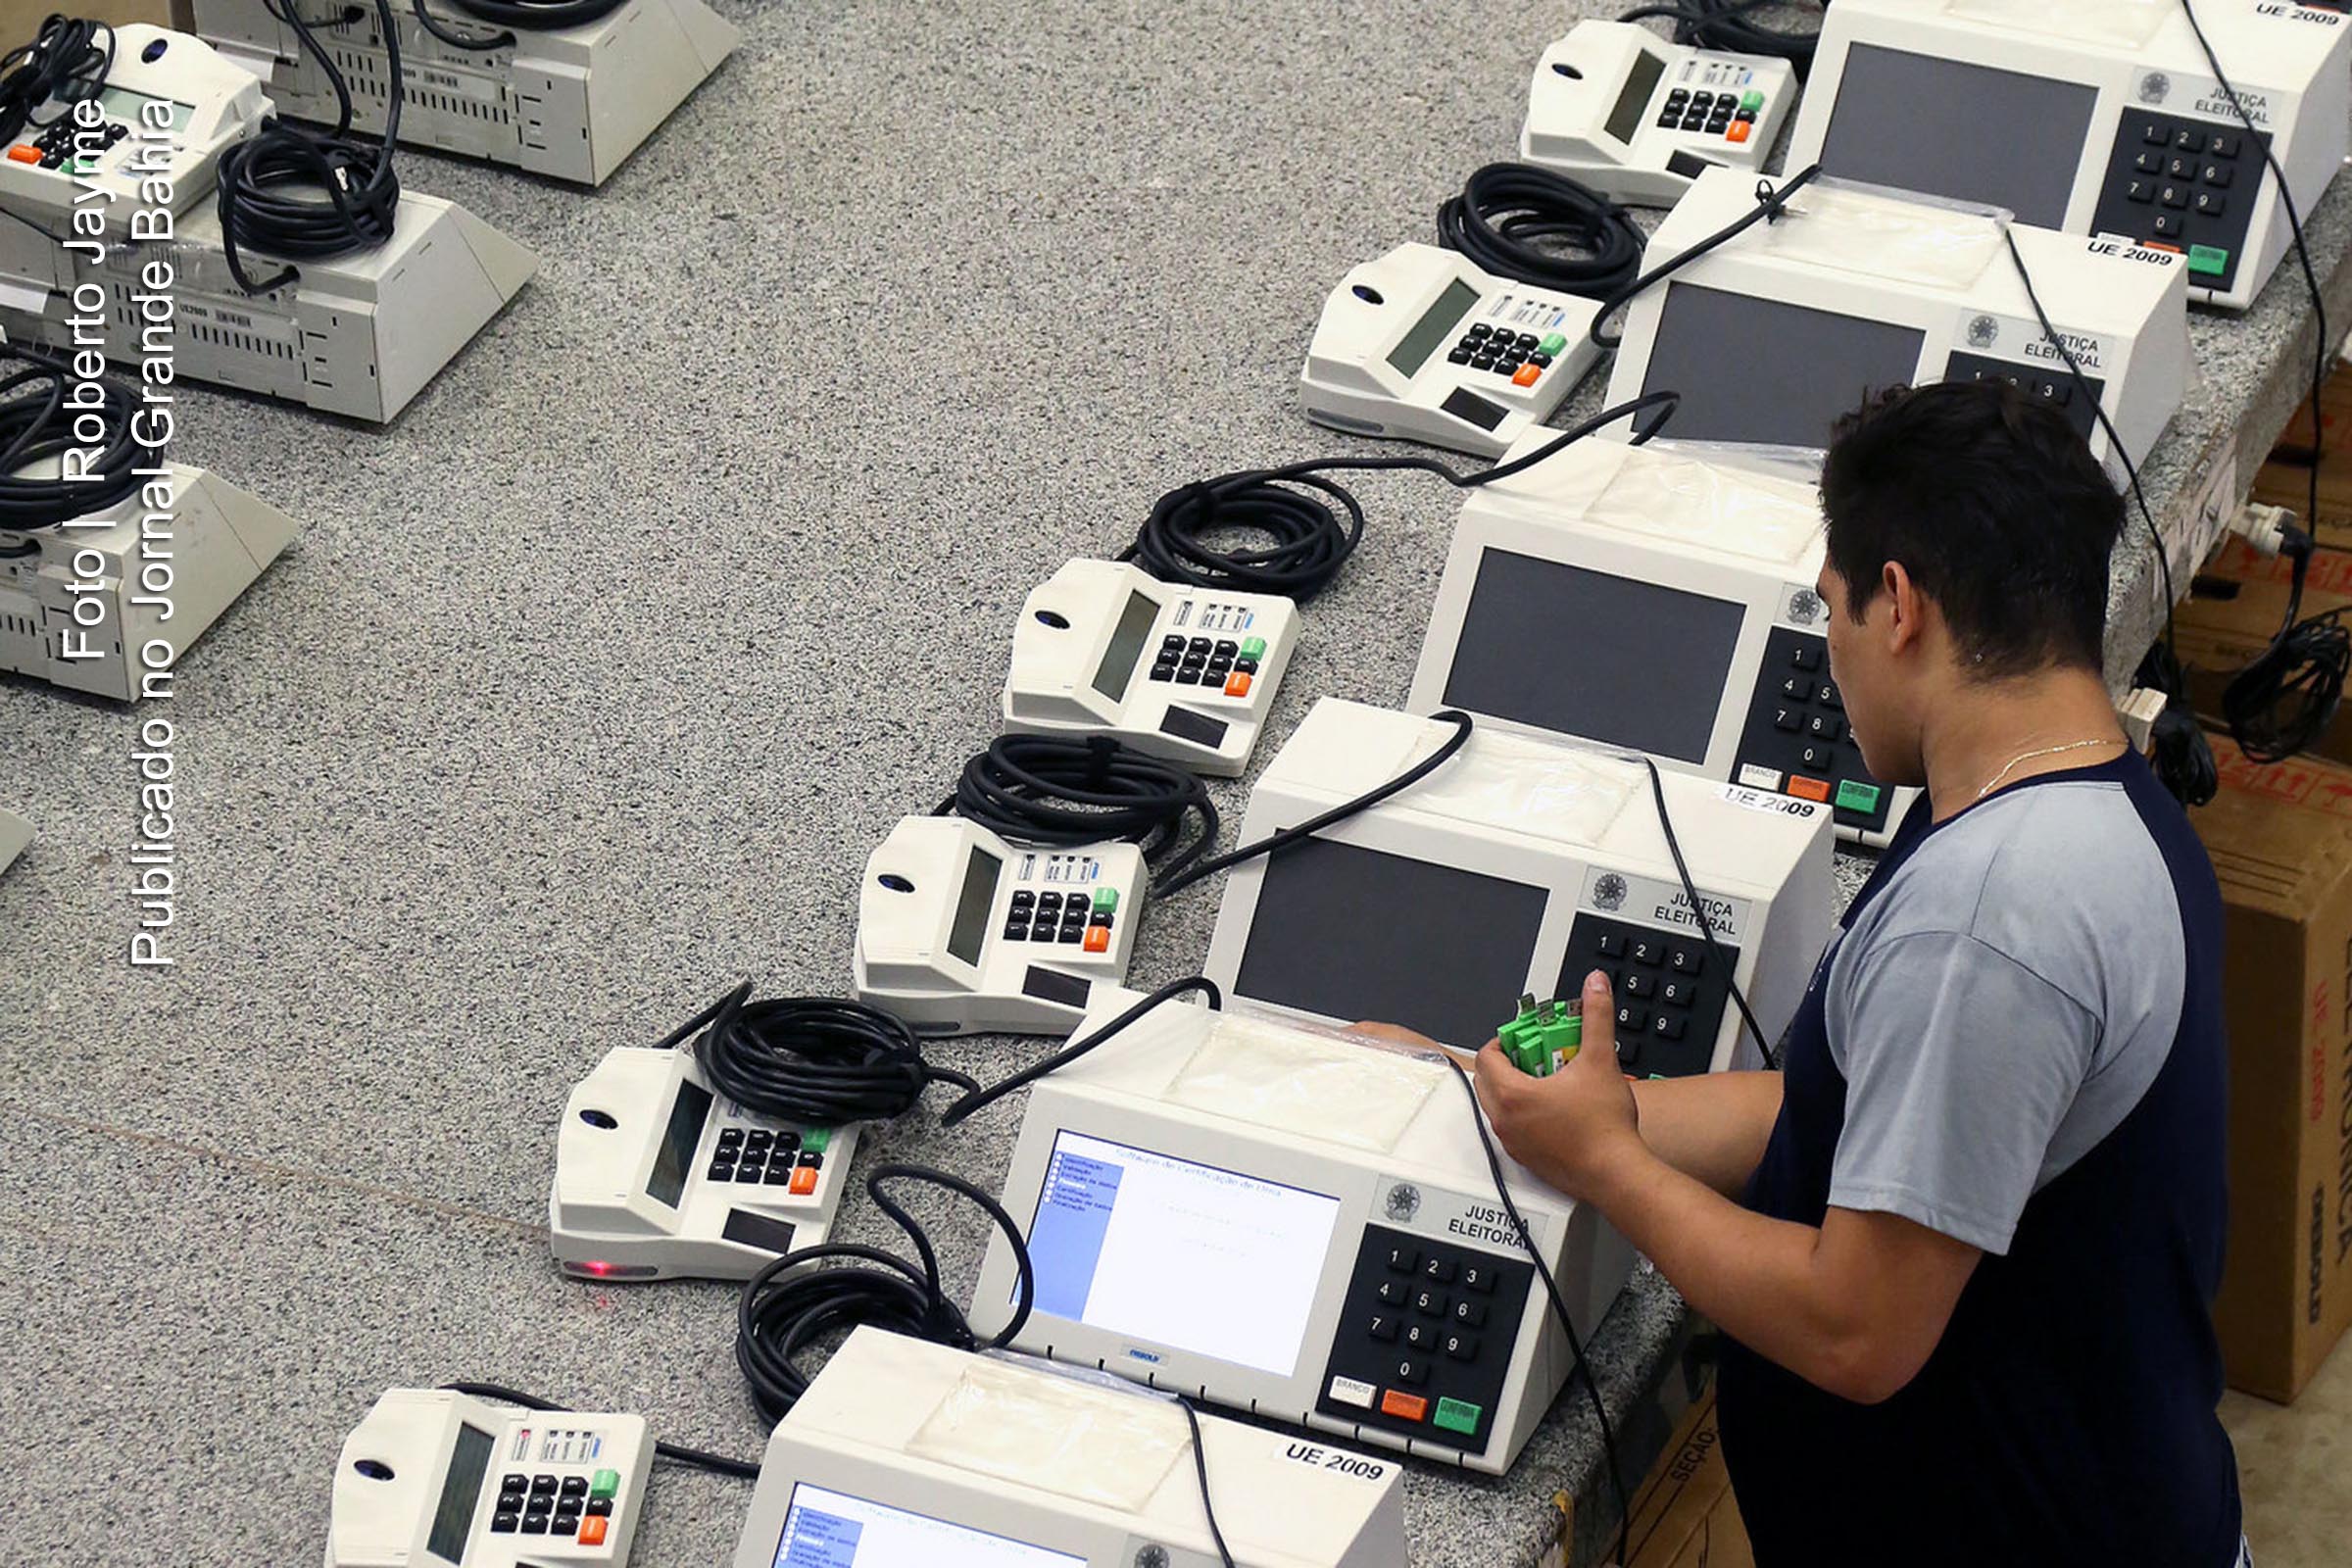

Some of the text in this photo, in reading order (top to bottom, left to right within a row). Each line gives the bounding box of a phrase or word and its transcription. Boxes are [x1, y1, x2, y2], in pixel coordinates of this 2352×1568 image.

[2256, 3, 2339, 26] UE 2009
[2087, 241, 2120, 256] UE
[2122, 248, 2174, 267] 2009
[2043, 384, 2052, 396] 3
[1795, 649, 1800, 660] 1
[1785, 679, 1830, 699] 4 5
[1777, 710, 1821, 729] 7 8
[1803, 748, 1813, 760] 0
[1725, 787, 1816, 818] UE 2009
[1671, 893, 1733, 917] JUTIÇA
[1601, 936, 1684, 965] 1 2 3
[1628, 976, 1675, 997] 5 6
[1618, 1008, 1666, 1029] 8 9
[1392, 1250, 1476, 1282] 1 2 3
[1379, 1283, 1467, 1315] 4 5 6
[1372, 1317, 1457, 1350] 7 8 9
[1399, 1362, 1409, 1375] 0
[1335, 1377, 1371, 1395] BRANCO
[1286, 1443, 1385, 1481] UE 2009
